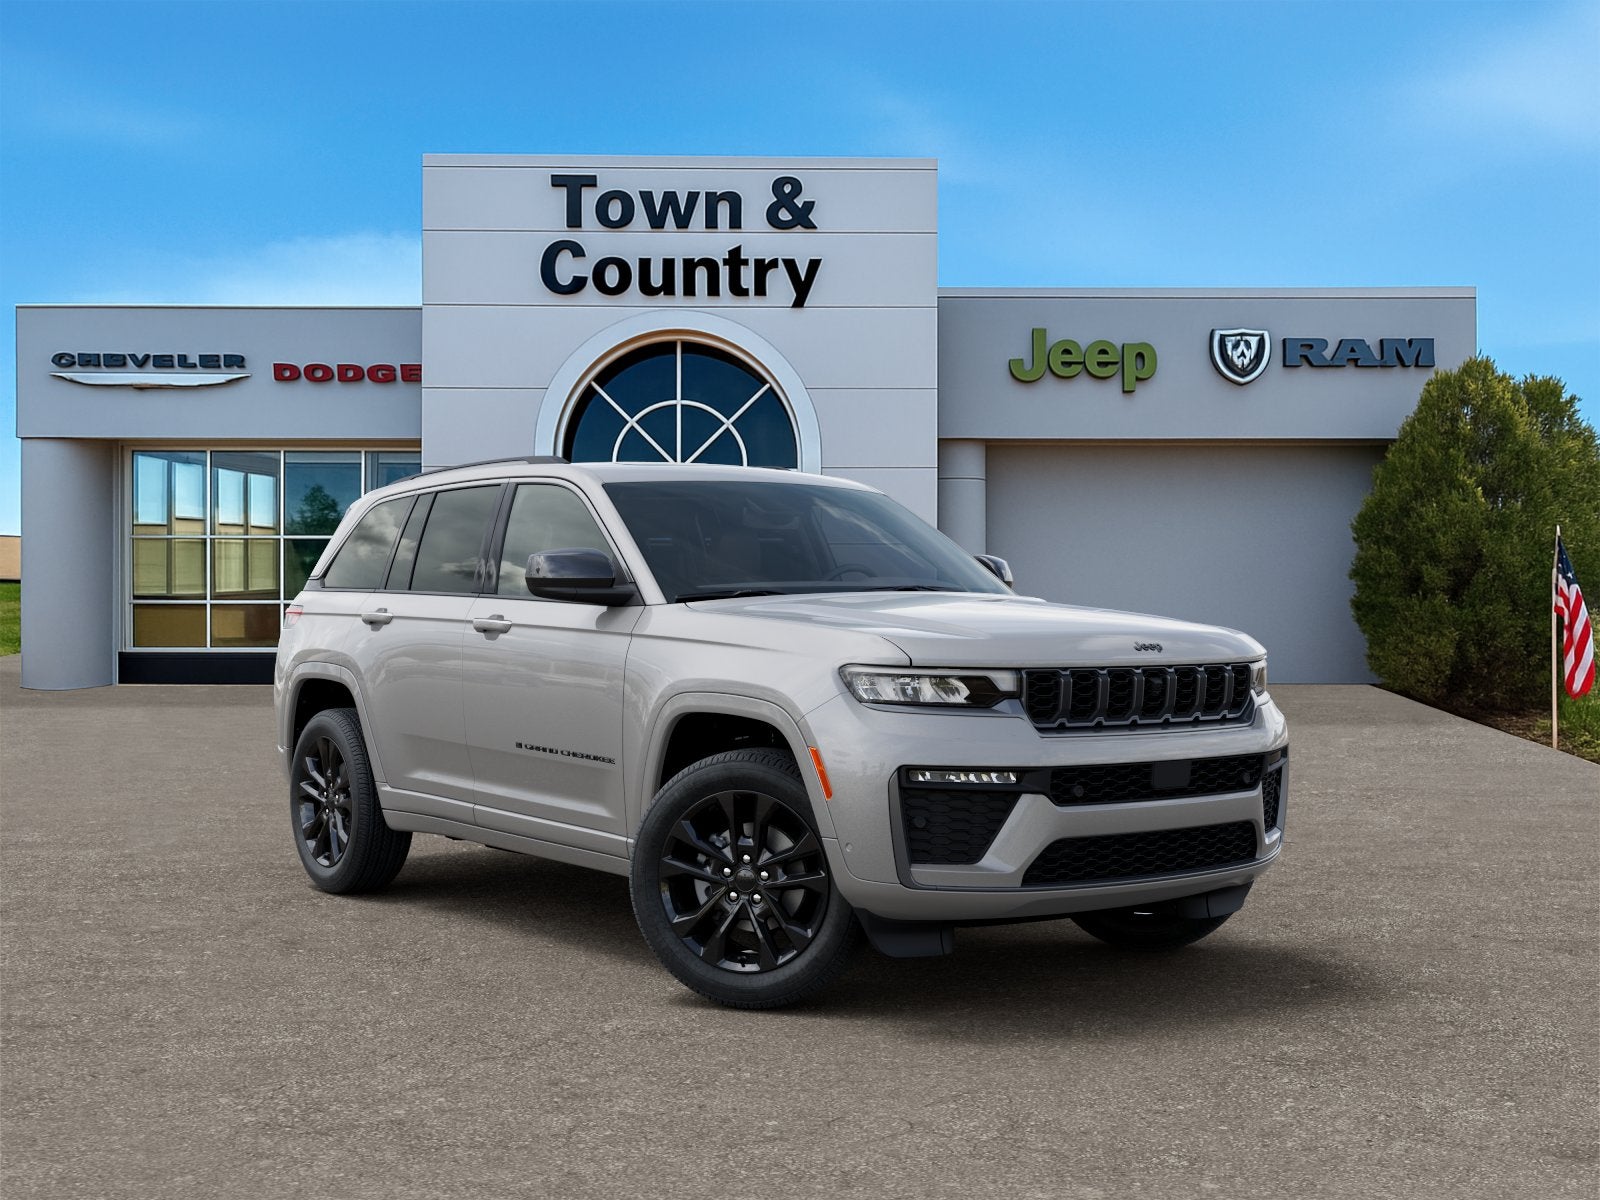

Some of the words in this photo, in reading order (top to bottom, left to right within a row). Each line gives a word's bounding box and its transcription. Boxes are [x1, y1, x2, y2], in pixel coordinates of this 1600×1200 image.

[550, 174, 743, 229] Town
[765, 176, 818, 230] &
[540, 240, 822, 308] Country
[273, 363, 422, 383] DODGE
[1009, 328, 1158, 393] Jeep
[1283, 338, 1435, 367] RAM
[1134, 641, 1163, 653] Jeep
